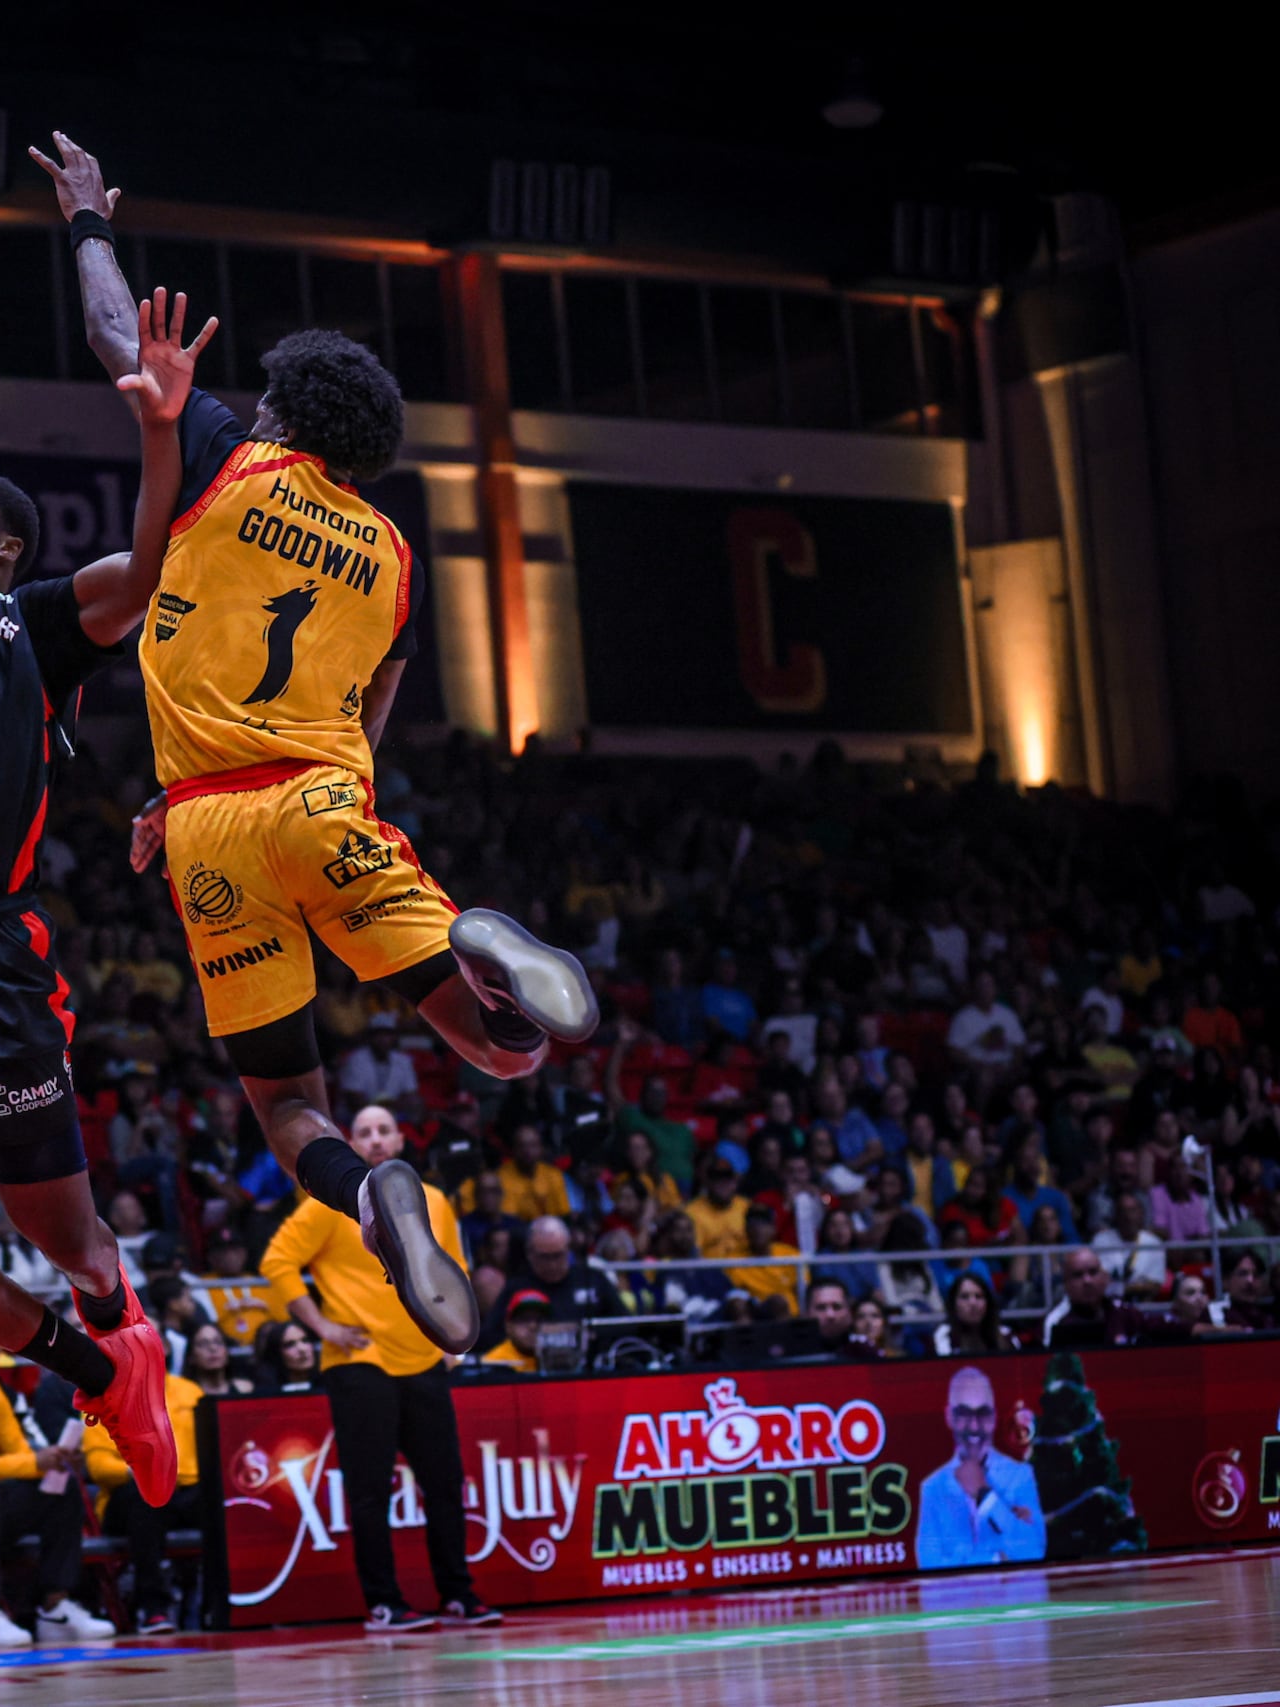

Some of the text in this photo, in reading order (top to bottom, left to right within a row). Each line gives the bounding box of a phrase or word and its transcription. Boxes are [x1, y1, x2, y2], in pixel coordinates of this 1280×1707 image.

[237, 507, 380, 597] GOODWIN
[269, 477, 378, 547] Humana
[241, 579, 322, 706] 1
[201, 936, 284, 980] WININ
[8, 1076, 58, 1105] CAMUY
[614, 1398, 886, 1479] AHORRO
[464, 1427, 588, 1562] July
[592, 1463, 912, 1558] MUEBLES
[602, 1542, 907, 1587] MUEBLES ENSERES MATTRESS
